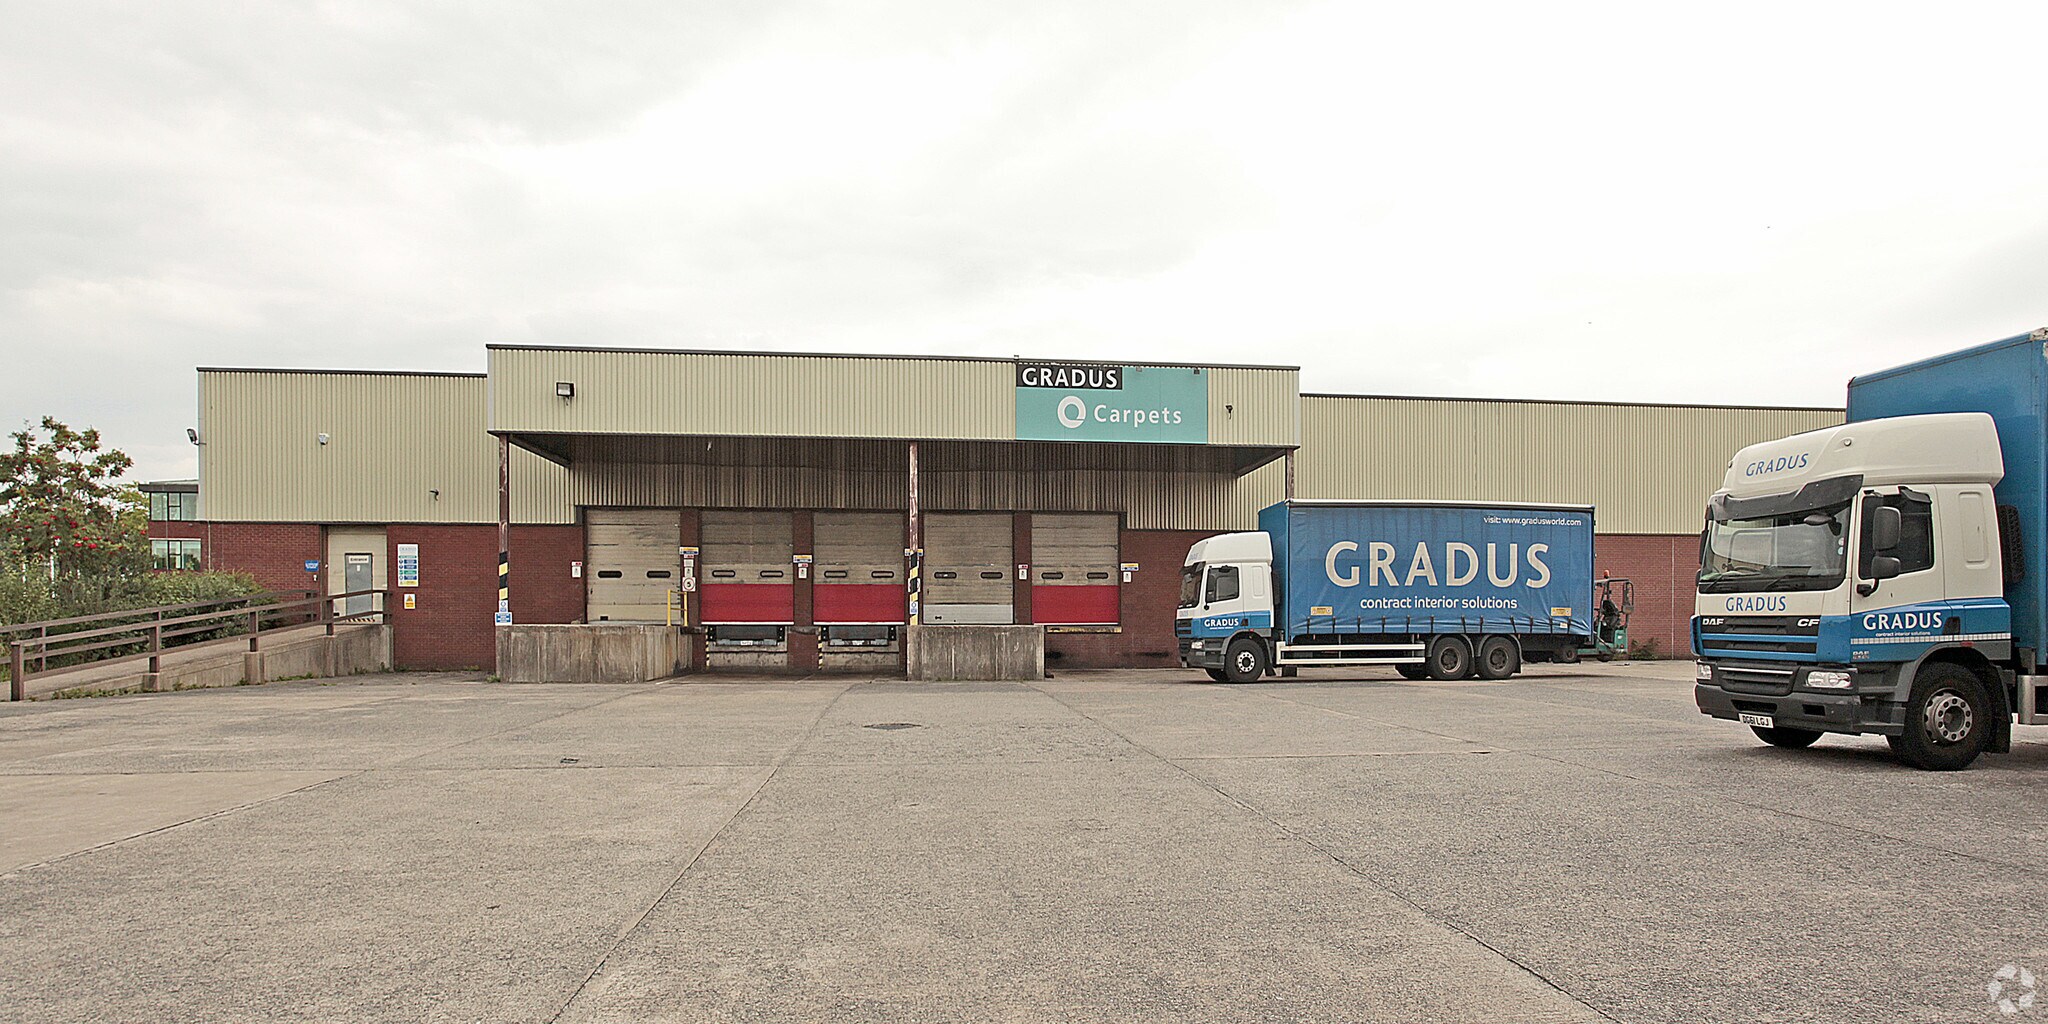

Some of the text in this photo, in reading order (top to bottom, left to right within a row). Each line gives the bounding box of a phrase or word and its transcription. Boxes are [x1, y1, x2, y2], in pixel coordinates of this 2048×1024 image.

[1021, 367, 1118, 389] GRADUS
[1093, 404, 1182, 428] Carpets
[1745, 453, 1809, 477] GRADUS
[1483, 515, 1582, 526] visit: www.gradusworld.com
[1325, 541, 1551, 588] GRADUS
[1360, 595, 1518, 609] contract interior solutions
[1725, 595, 1787, 612] GRADUS
[1204, 618, 1240, 628] GRADUS
[1702, 618, 1725, 626] DAF
[1797, 618, 1820, 628] CF
[1863, 612, 1942, 630] GRADUS
